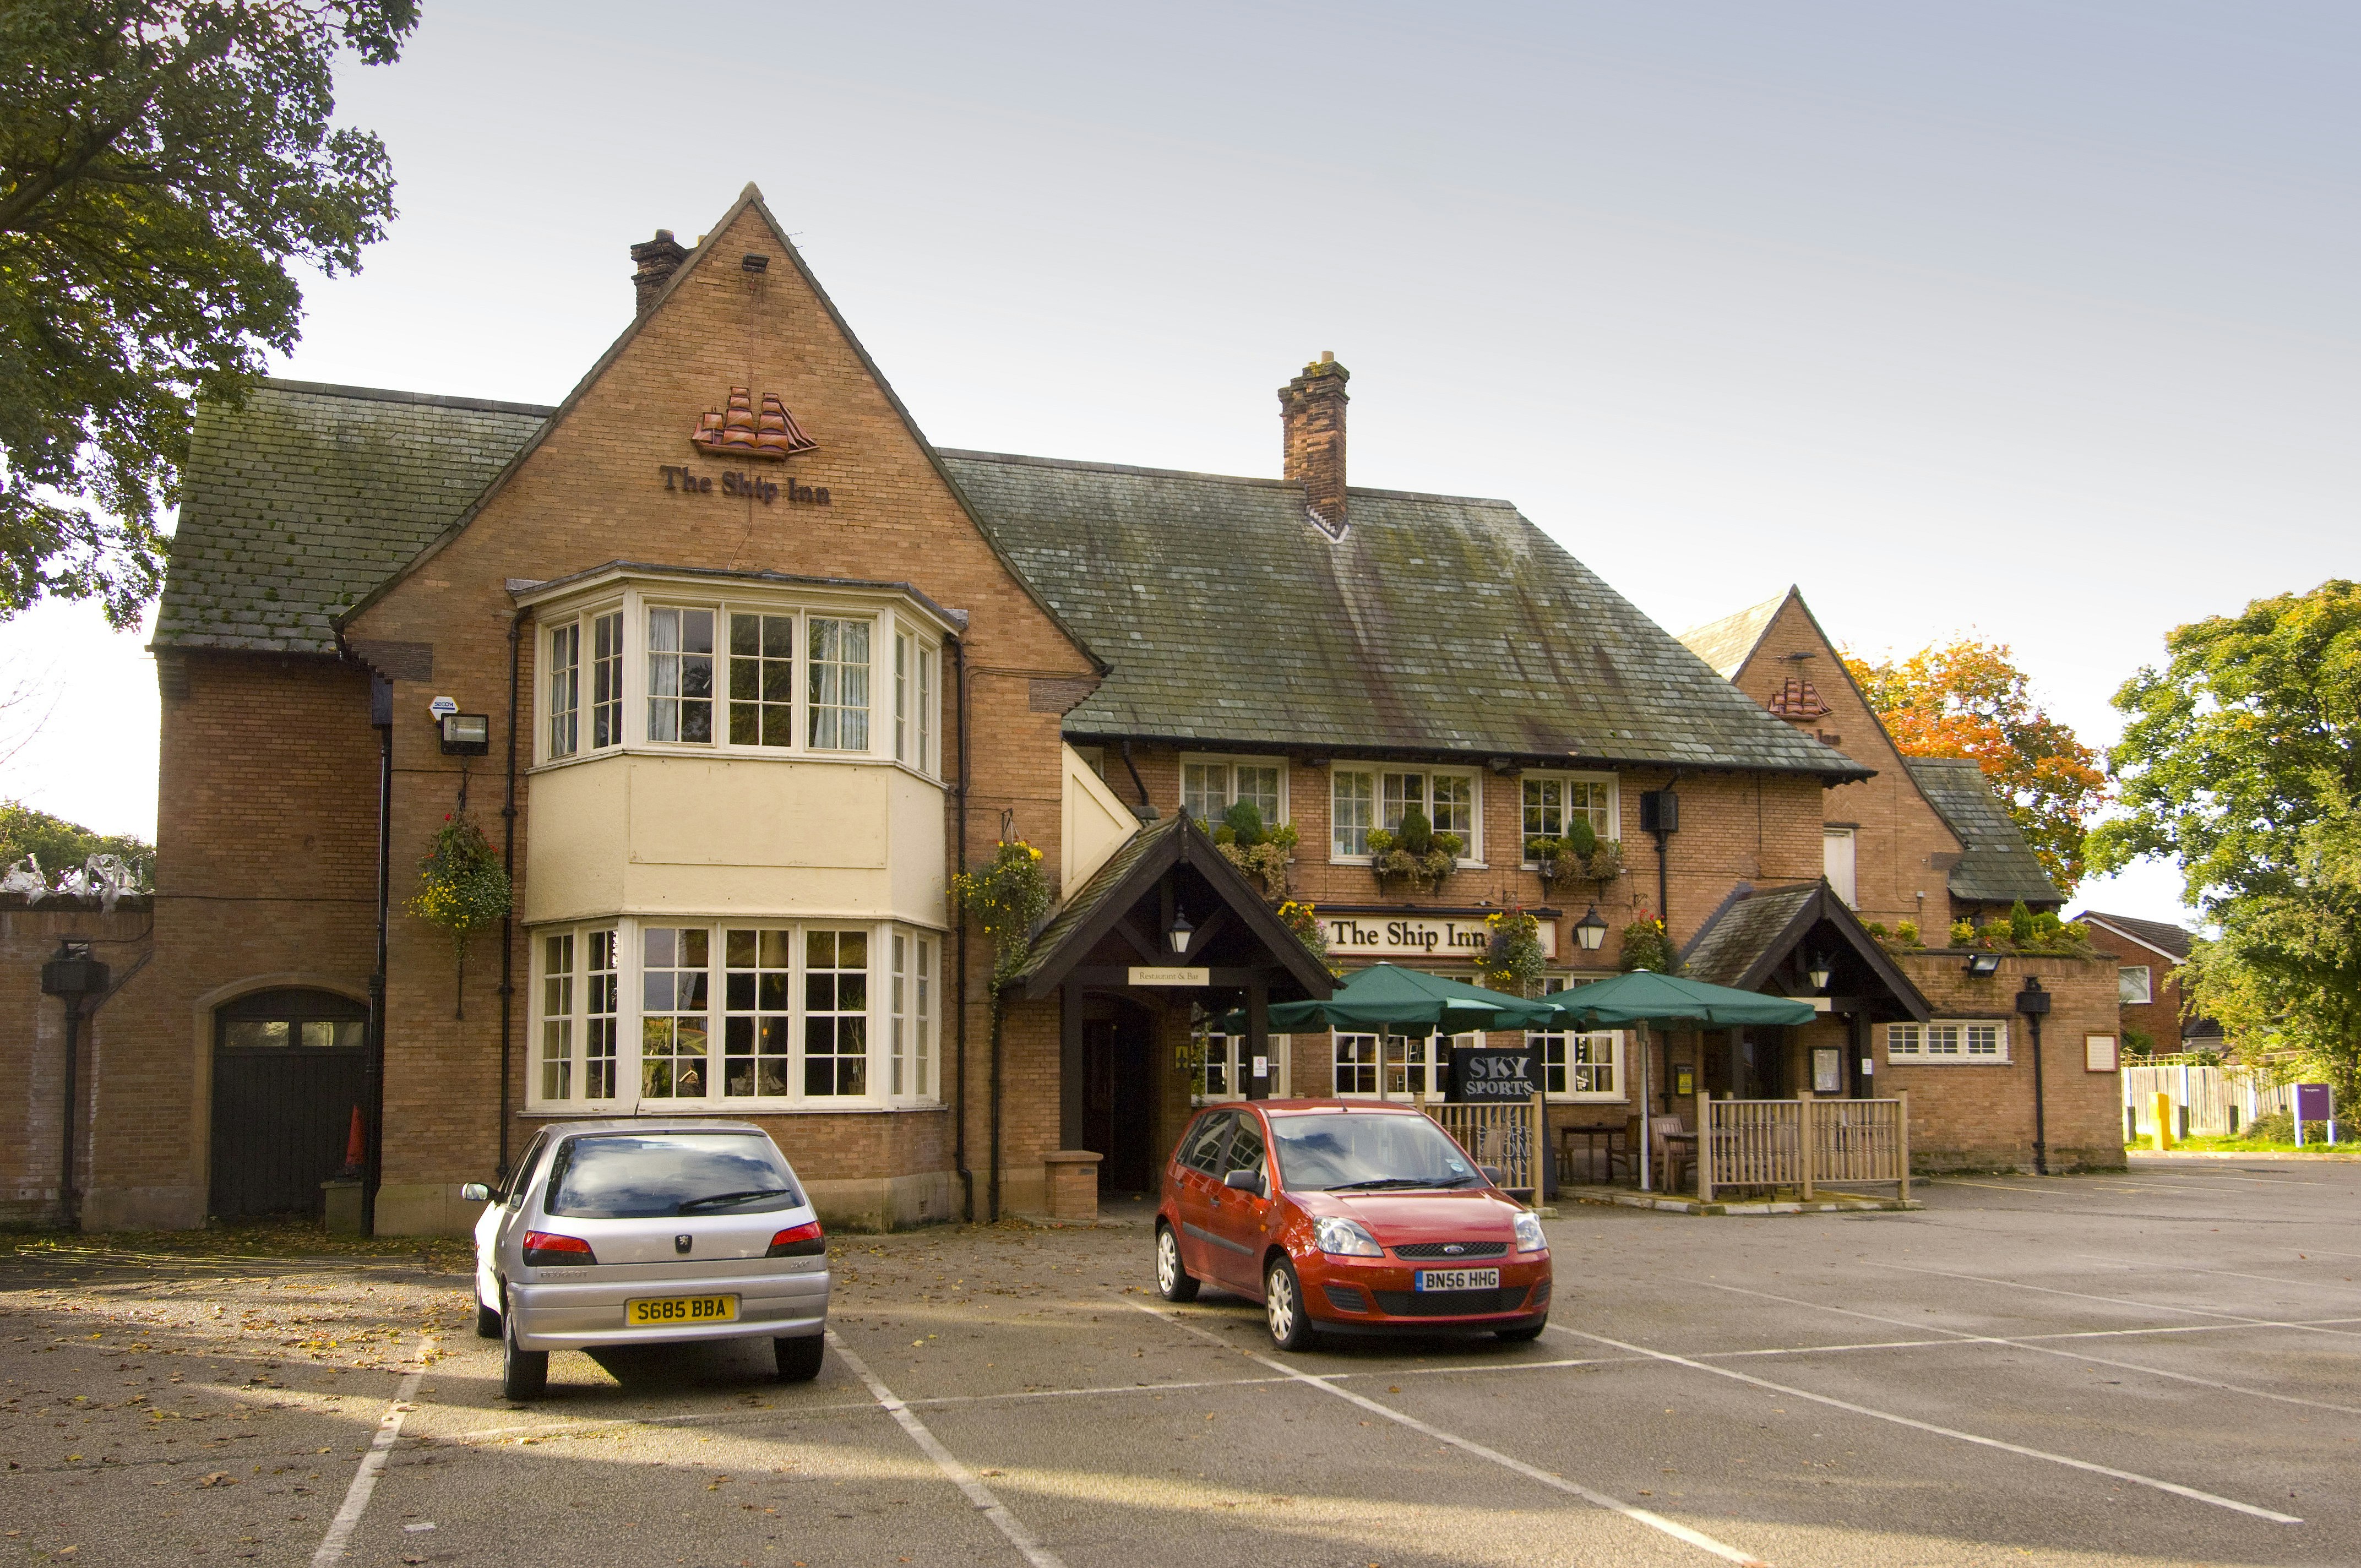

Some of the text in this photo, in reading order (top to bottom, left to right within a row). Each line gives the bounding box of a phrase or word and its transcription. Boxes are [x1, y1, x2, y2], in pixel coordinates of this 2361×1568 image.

[660, 465, 831, 506] The Ship Inn
[1331, 921, 1486, 951] The Ship Inn
[1139, 972, 1198, 980] Restaurant & Bar
[1469, 1057, 1531, 1080] SKY
[1465, 1081, 1535, 1096] SPORTS
[1426, 1271, 1497, 1288] BN56 HHG
[638, 1299, 726, 1320] S685 BBA
